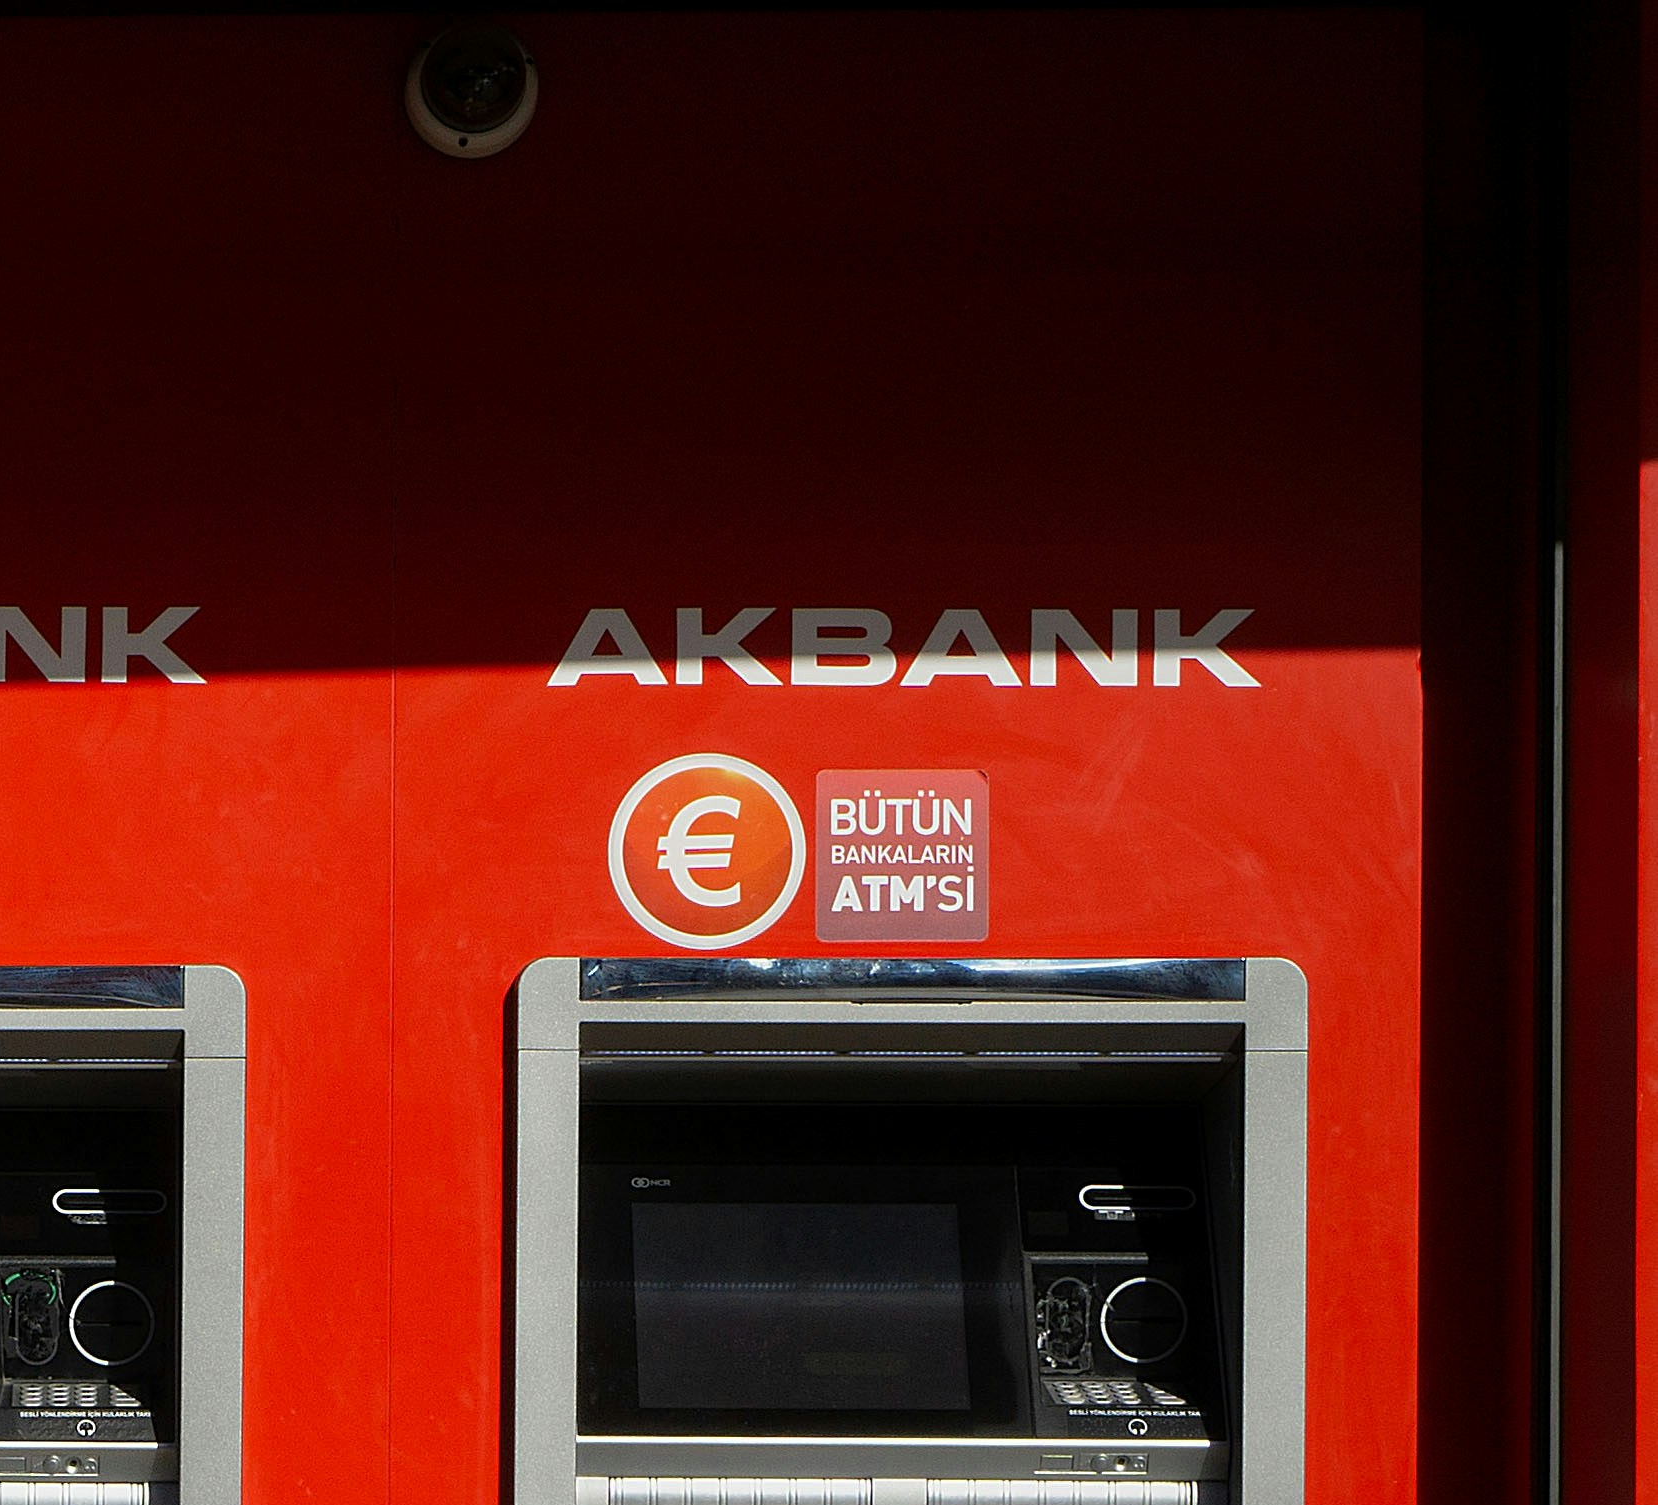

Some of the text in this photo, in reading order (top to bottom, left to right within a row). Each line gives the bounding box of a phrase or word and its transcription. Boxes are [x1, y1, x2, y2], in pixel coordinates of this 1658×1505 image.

[546, 608, 1262, 688] AKBANK
[830, 789, 973, 837] BÜTÜN
[831, 845, 974, 865] BANKALARIN
[831, 866, 975, 913] ATM'Sİ
